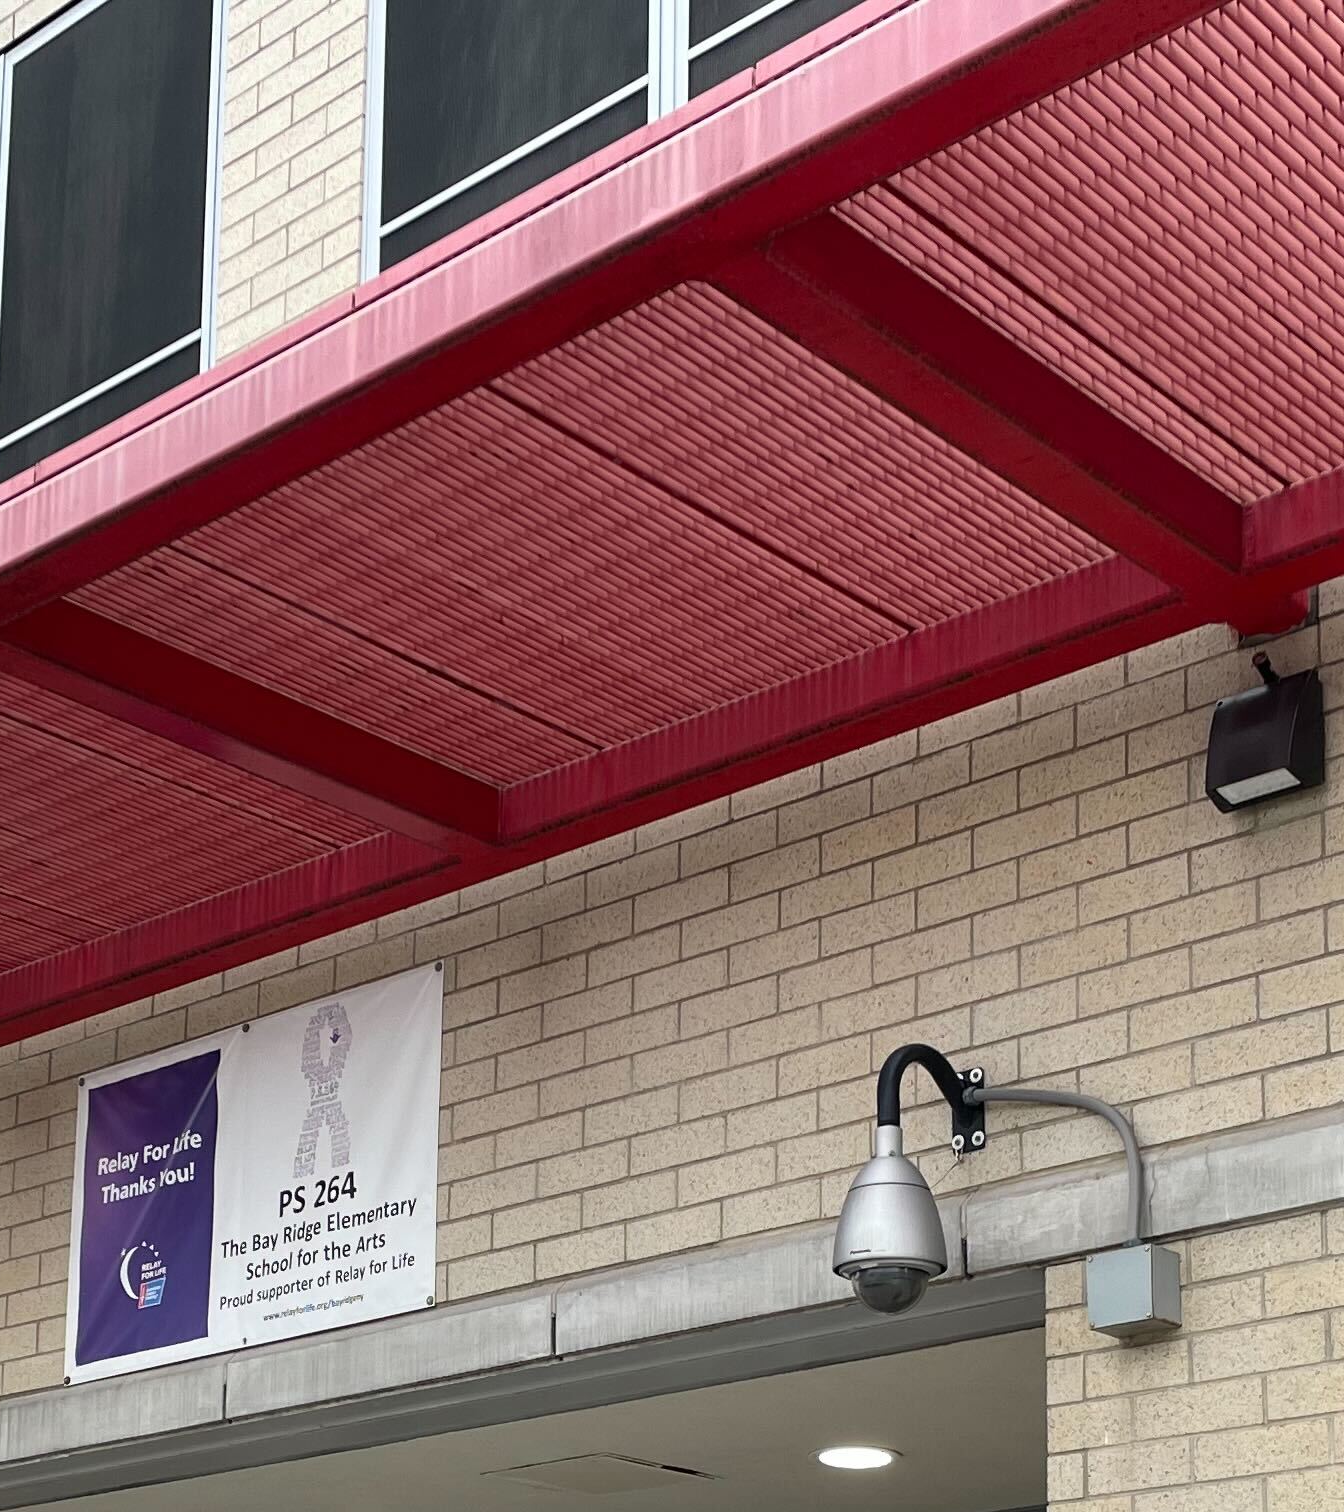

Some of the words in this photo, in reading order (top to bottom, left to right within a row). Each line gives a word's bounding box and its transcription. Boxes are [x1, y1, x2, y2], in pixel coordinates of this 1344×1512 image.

[97, 1152, 139, 1175] Relay
[143, 1144, 170, 1163] For
[172, 1129, 202, 1154] Life
[101, 1176, 156, 1204] Thanks
[159, 1161, 195, 1187] You!
[279, 1186, 306, 1217] PS
[313, 1171, 357, 1208] 264
[221, 1239, 248, 1259] The
[252, 1232, 279, 1256] Bay
[283, 1221, 321, 1244] Ridge
[327, 1198, 417, 1232] Elementary
[246, 1252, 293, 1280] School
[297, 1249, 319, 1271] for
[324, 1242, 351, 1261] the
[356, 1233, 386, 1254] Arts
[219, 1289, 254, 1310] Proud
[256, 1278, 314, 1304] supporter
[317, 1271, 331, 1287] of
[335, 1266, 366, 1285] Relay
[369, 1258, 388, 1276] for
[392, 1252, 416, 1270] Life
